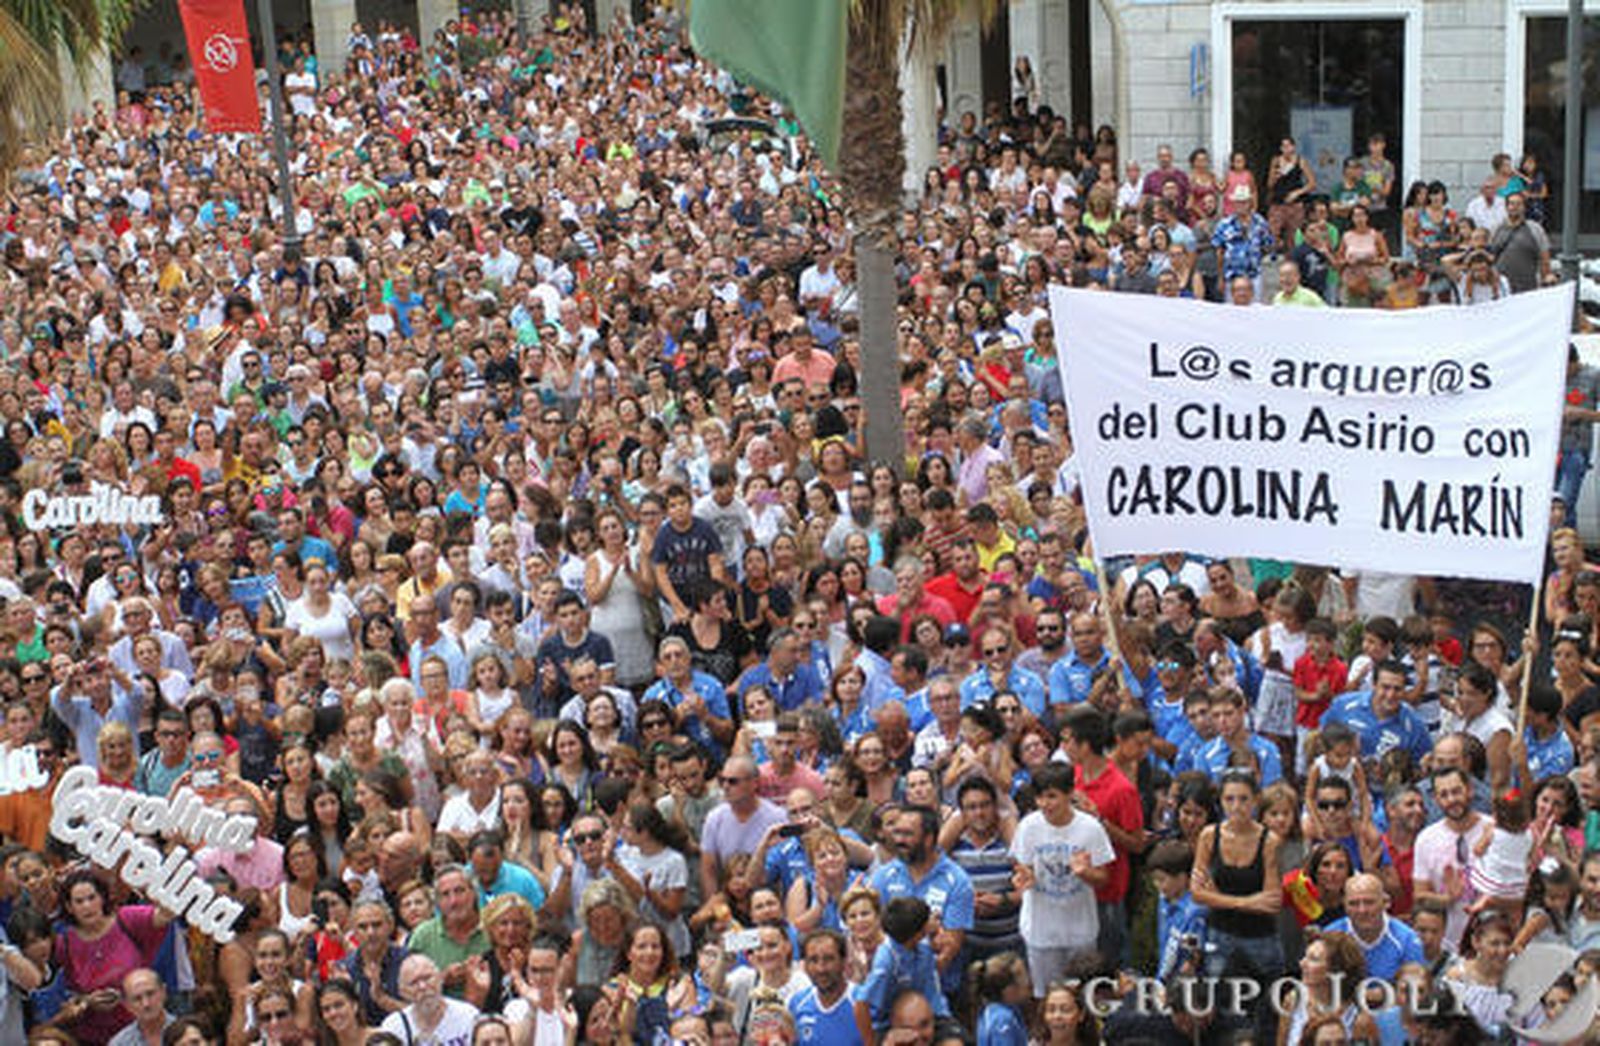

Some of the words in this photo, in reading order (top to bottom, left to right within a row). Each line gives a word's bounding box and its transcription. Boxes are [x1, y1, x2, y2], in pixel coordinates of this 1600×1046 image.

[1150, 342, 1252, 381] L@s
[1271, 359, 1492, 396] arquer@s
[1099, 402, 1157, 440] del
[1175, 402, 1286, 441] Club
[1300, 406, 1434, 454] Asirio
[1464, 428, 1530, 457] con
[23, 480, 164, 532] Carolina
[1107, 464, 1338, 526] CAROLINA
[1380, 472, 1523, 539] MARÍN
[50, 790, 244, 944] Carolina
